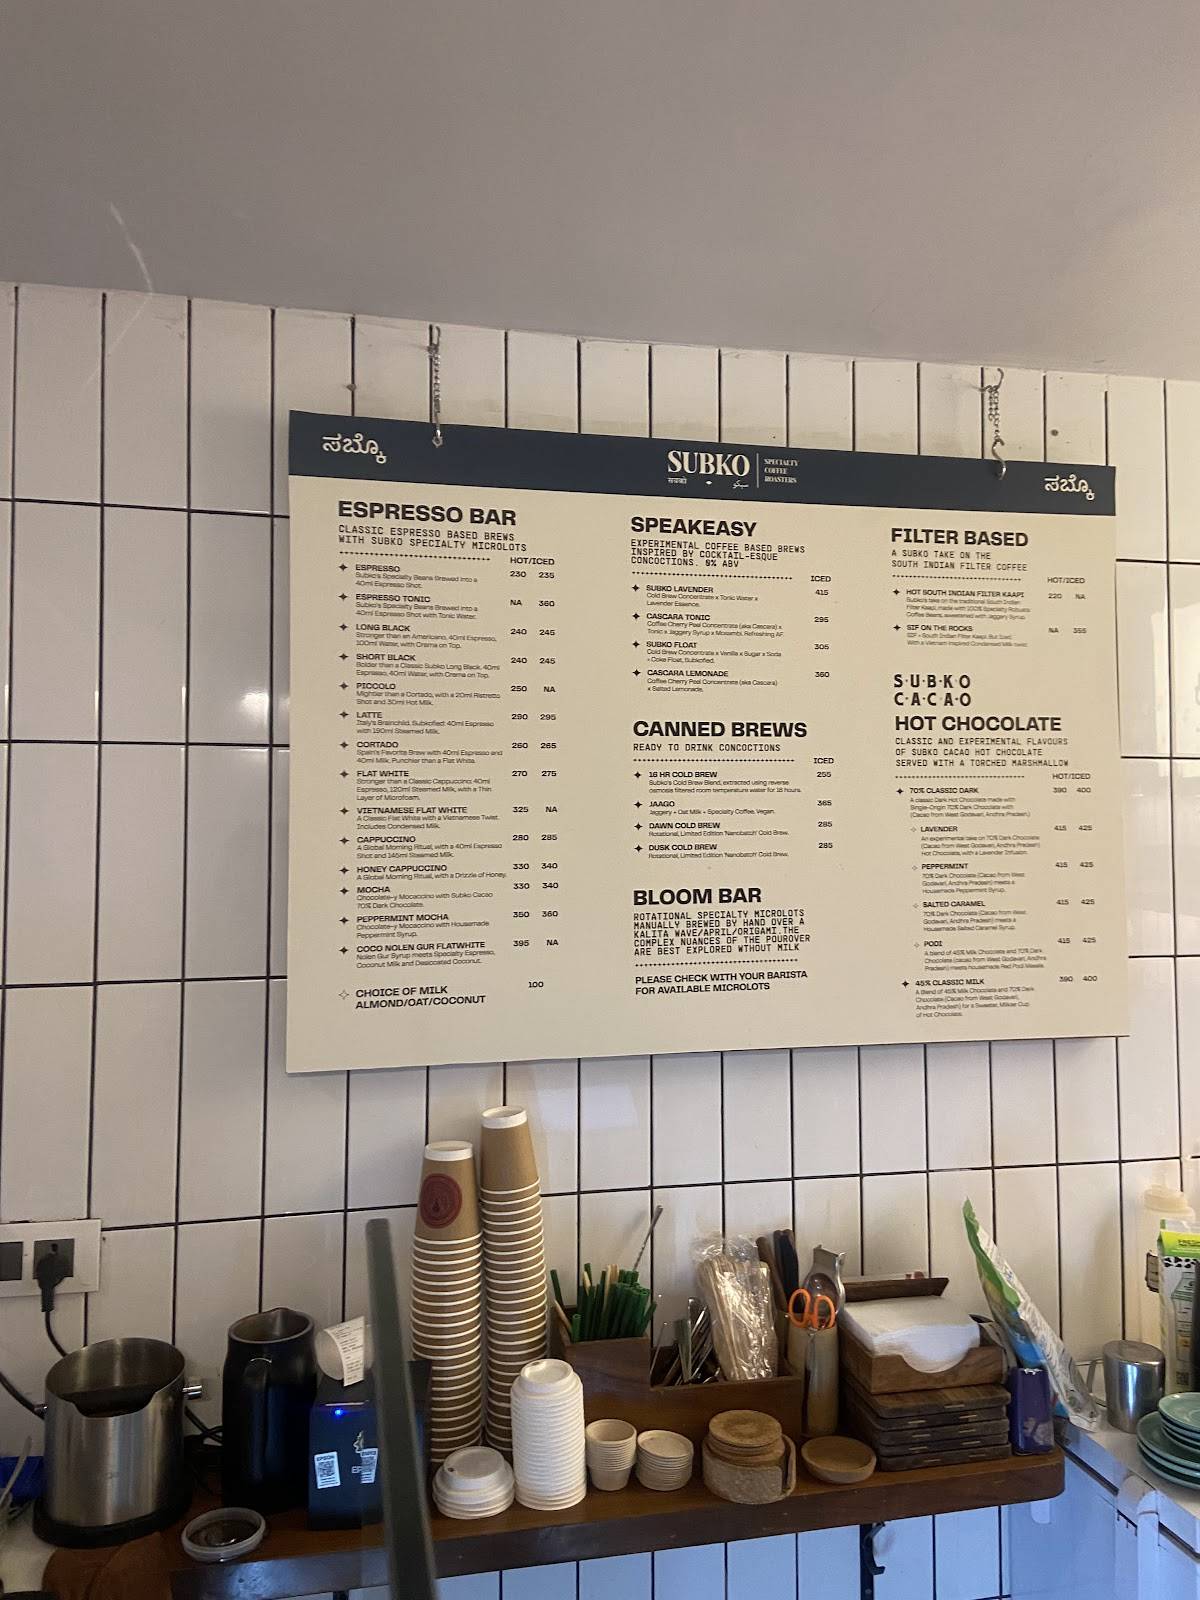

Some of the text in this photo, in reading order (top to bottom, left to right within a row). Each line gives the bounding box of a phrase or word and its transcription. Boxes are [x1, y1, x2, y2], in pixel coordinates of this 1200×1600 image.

[667, 450, 750, 477] SUBKO
[764, 476, 798, 484] ROASTERS
[338, 500, 516, 526] ESPRESSO BAR
[631, 516, 757, 537] SPEAKEASY
[339, 524, 514, 541] CLASSIC ESPRESSO BASED BREWS
[891, 527, 1028, 547] FILTER BASED
[338, 534, 527, 552] WITH SUBKO SPECIALTY MICROLOTS
[631, 538, 805, 553] EXPERIMENTAL COFFEE BASED BREWS
[631, 547, 778, 561] INSPIRED BY COCKTAIL-ESQUE
[510, 557, 555, 565] HOT/ICED
[891, 559, 1027, 571] SOUTH INDIAN FILTER COFFEE
[355, 564, 401, 572] ESPRESSO
[510, 570, 555, 579] 230 235
[1047, 576, 1086, 584] HOT/ICED
[646, 584, 672, 592] SUBKO
[355, 593, 431, 603] ESPRESSO TONIC
[646, 612, 684, 620] CASCARA
[356, 623, 410, 632] LONG BLACK
[646, 640, 673, 648] SUBKO
[356, 682, 396, 690] PICCOLO
[356, 711, 383, 719] LATTE
[895, 715, 1062, 731] HOT CHOCOLATE
[633, 720, 807, 738] CANNED BREWS
[895, 737, 1068, 745] CLASSIC AND EXPERIMENTAL FLAVOURS
[633, 743, 780, 752] READY TO DRINK CONCOCTIONS
[416, 806, 436, 814] FLAT
[356, 864, 447, 873] HONEY CAPPUCCINO
[356, 886, 390, 894] MOCHA
[513, 882, 530, 890] 330
[633, 887, 761, 906] BLOOM BAR
[356, 913, 449, 923] PEPPERMINT MOCHA
[633, 908, 804, 921] ROTATIONAL SPECIALTY MICROLOTS
[356, 945, 383, 953] COCO
[436, 941, 485, 950] FLATWHITE
[635, 970, 808, 984] PLEASE CHECK WITH YOUR BARISTA
[355, 985, 448, 998] CHOICE OF MILK
[635, 982, 770, 995] FOR AVAILABLE MICROLOTS
[355, 995, 486, 1009] ALMOND/OAT/COCONUT
